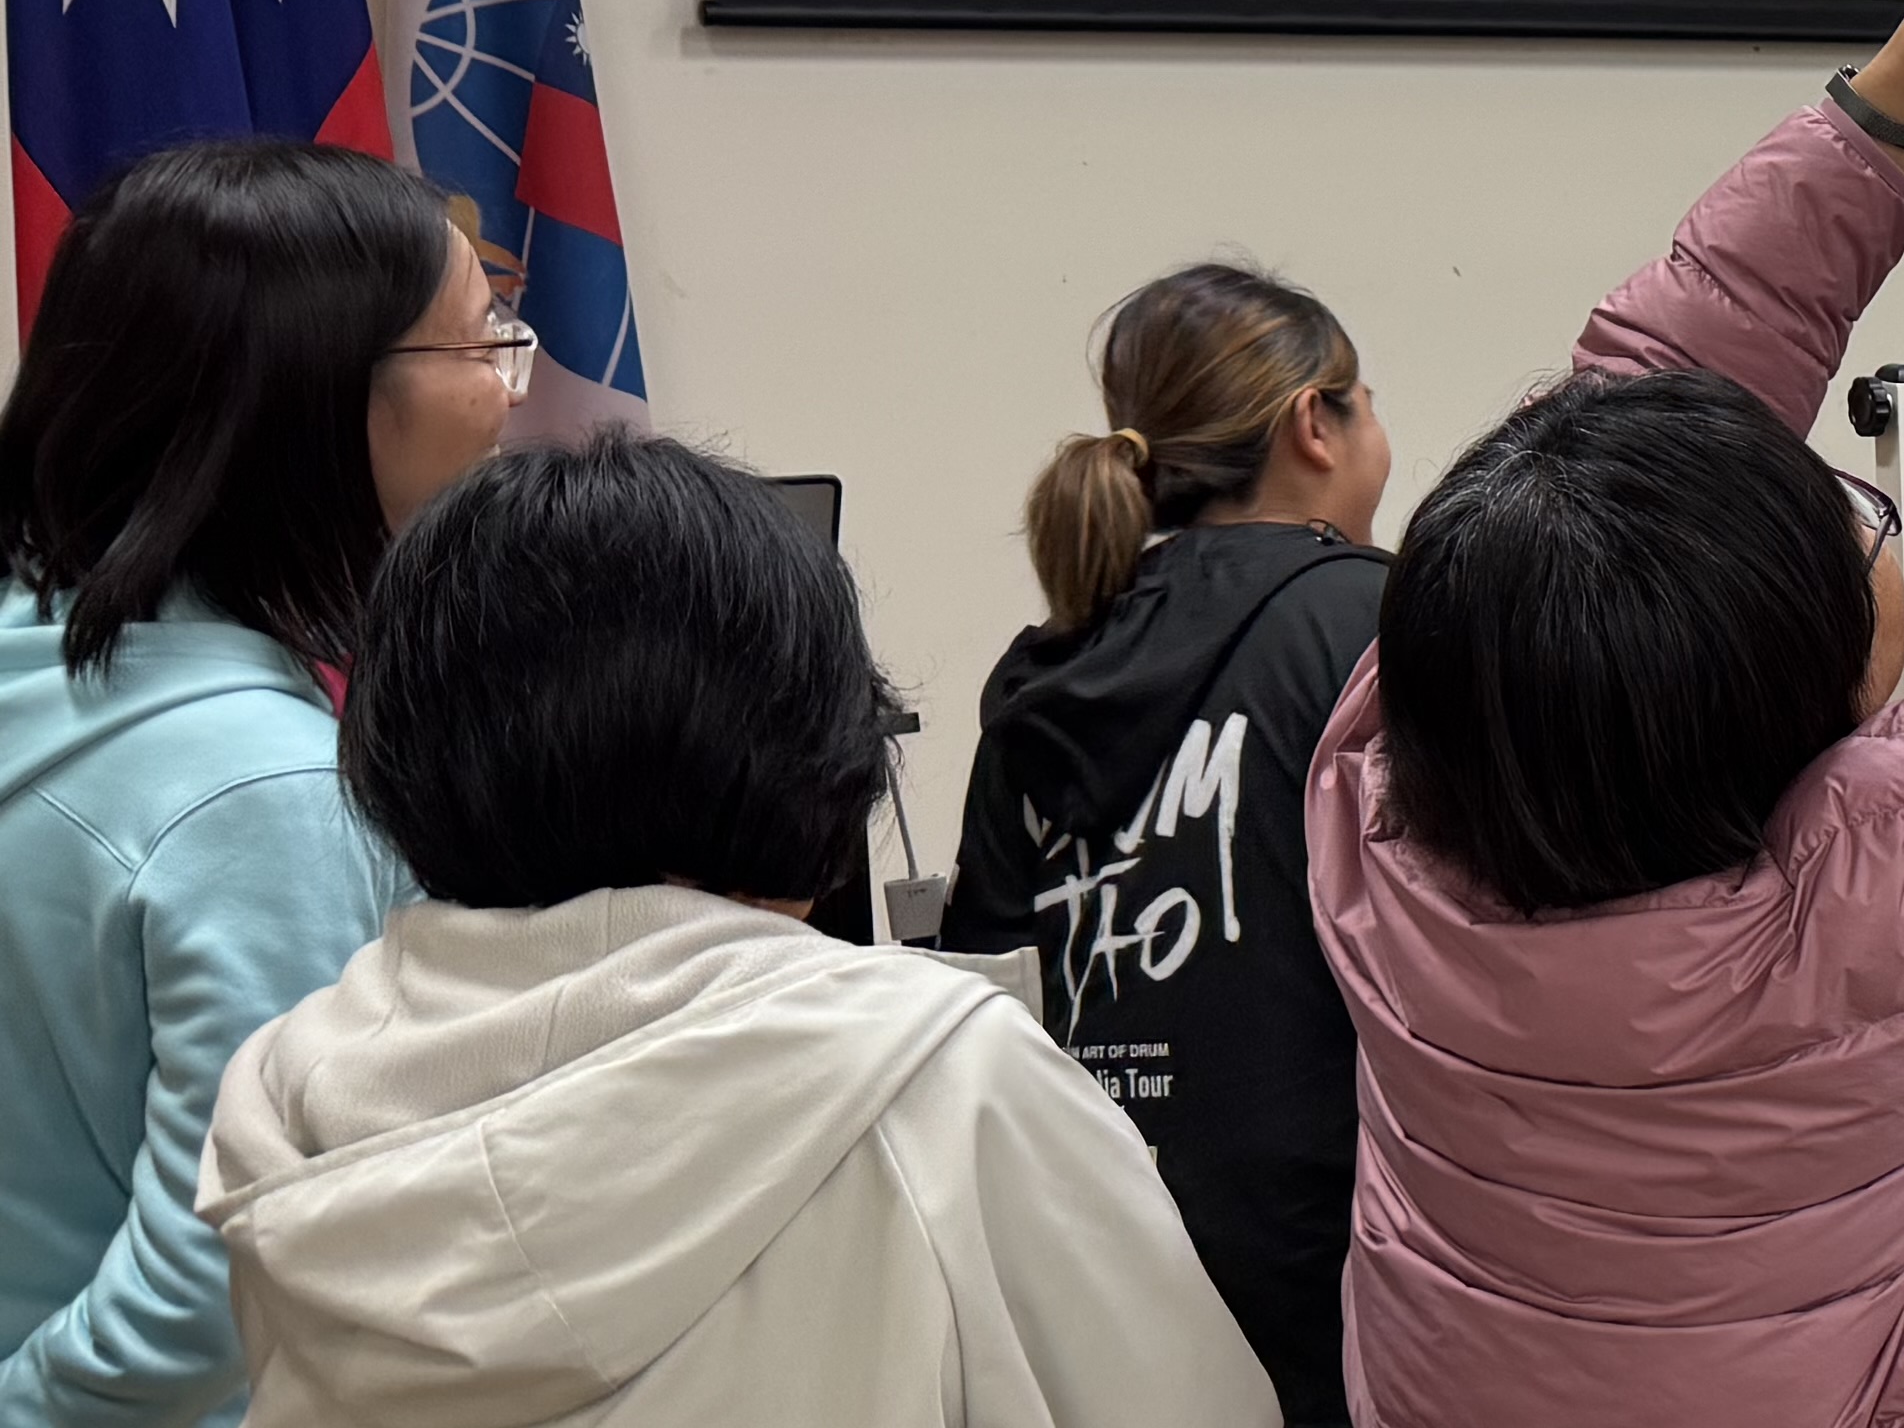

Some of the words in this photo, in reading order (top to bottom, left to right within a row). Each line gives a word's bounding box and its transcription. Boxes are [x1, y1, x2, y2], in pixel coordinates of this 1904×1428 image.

[1082, 1045, 1106, 1061] ART
[1108, 1044, 1128, 1059] OF
[1129, 1042, 1170, 1058] DRUM
[1125, 1068, 1174, 1099] Tour
